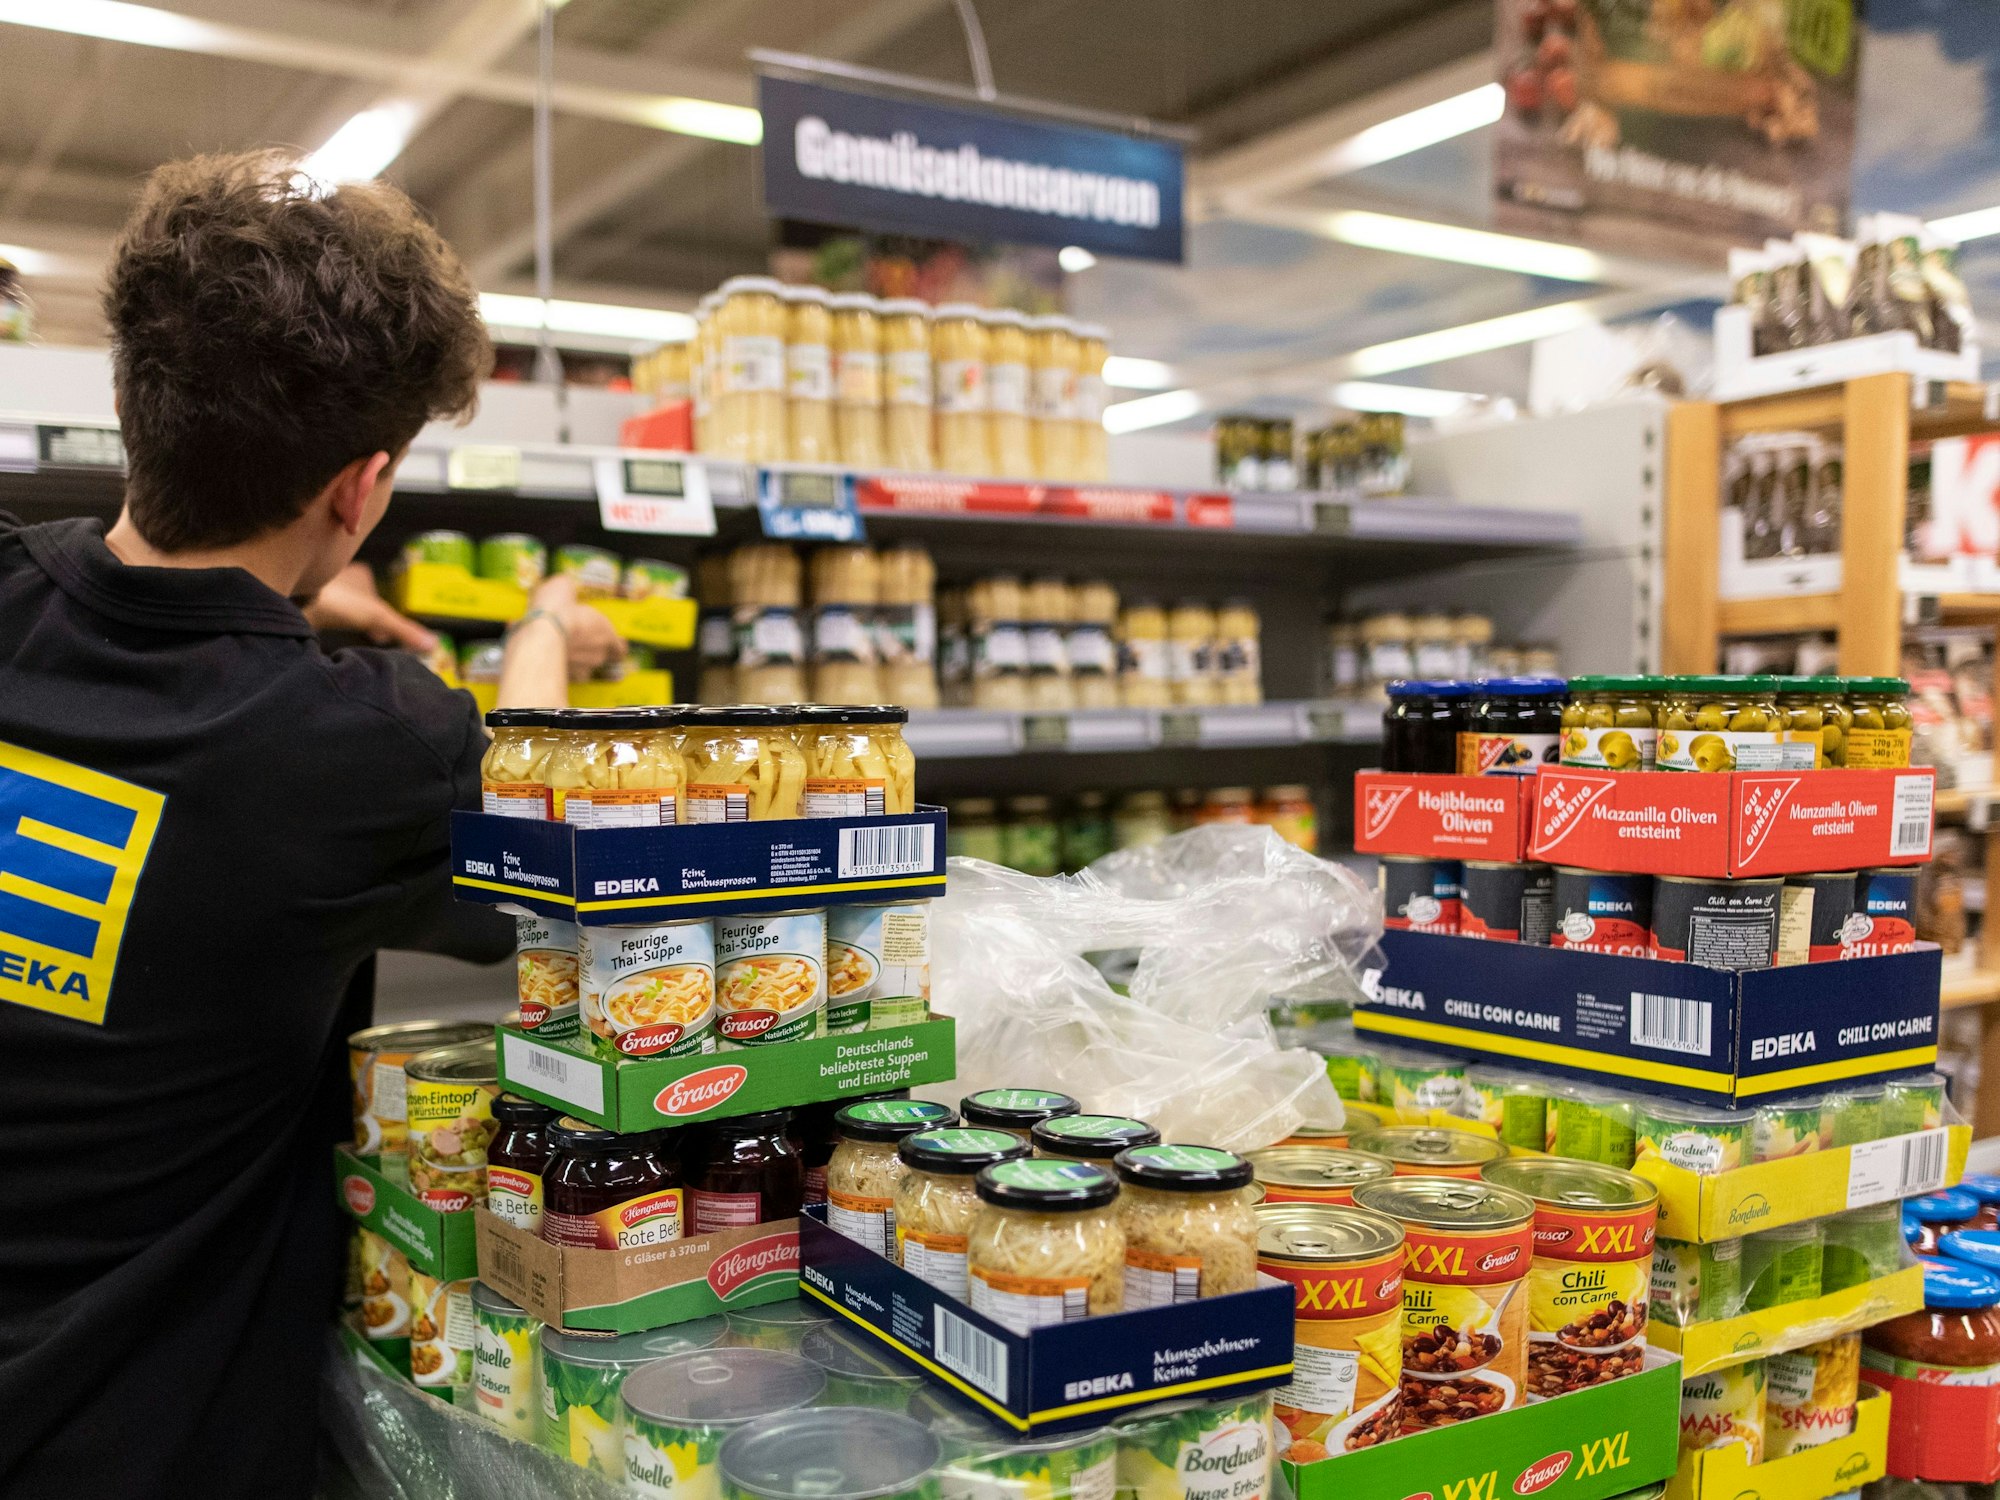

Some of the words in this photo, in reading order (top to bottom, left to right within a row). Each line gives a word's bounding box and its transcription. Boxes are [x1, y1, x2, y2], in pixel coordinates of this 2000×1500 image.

[794, 115, 1161, 229] Gemüsekonserven
[1418, 790, 1505, 817] Hojiblanca
[1543, 781, 1565, 807] GUT
[1744, 786, 1763, 815] GUT
[1544, 785, 1592, 836] GÜNSTIG
[1592, 803, 1666, 823] Mazanilla
[1670, 806, 1718, 824] Oliven
[1746, 787, 1782, 846] GÜNSTIG
[1789, 801, 1846, 820] Manzanilla
[1848, 799, 1878, 817] Oliven
[1442, 812, 1494, 834] Oliven
[1618, 824, 1681, 840] entsteint
[1812, 821, 1855, 836] entsteint
[465, 859, 496, 877] EDEKA
[503, 850, 521, 866] Feine
[842, 867, 847, 876] 4
[852, 864, 886, 876] 311501
[890, 862, 922, 873] 351611
[503, 866, 560, 888] Bambussprossen
[681, 867, 706, 878] Feine
[681, 875, 757, 890] Bambussprossen
[594, 877, 660, 896] EDEKA
[1588, 900, 1634, 912] EDEKA
[1867, 900, 1907, 911] EDEKA
[721, 924, 765, 940] Feurige
[621, 934, 669, 953] Feurige
[611, 943, 683, 971] Thai-Suppe
[721, 1014, 774, 1033] Erasco
[1444, 998, 1481, 1020] CHILI
[1482, 1004, 1513, 1026] CON
[1514, 1010, 1561, 1033] CARNE
[538, 1021, 564, 1034] Natürlich
[764, 1024, 794, 1041] Natürlich
[794, 1019, 809, 1033] lecker
[1751, 1031, 1816, 1061] EDEKA
[1838, 1025, 1870, 1047] CHILI
[1872, 1020, 1896, 1041] CON
[1897, 1015, 1933, 1038] CARNE
[622, 1028, 679, 1053] Erasco
[670, 1038, 697, 1055] Natürlich
[837, 1036, 914, 1059] Deutschlands
[820, 1057, 885, 1077] beliebteste
[887, 1051, 929, 1071] Suppen
[838, 1074, 861, 1090] und
[863, 1067, 911, 1087] Eintöpfe
[667, 1072, 740, 1113] Erasco
[506, 1198, 538, 1216] Bete
[1728, 1201, 1772, 1226] Bonduelle
[618, 1228, 655, 1247] Rote
[659, 1219, 681, 1240] Bete
[1575, 1224, 1637, 1254] XXL
[625, 1255, 632, 1267] 6
[634, 1249, 667, 1266] Gläser
[669, 1246, 676, 1258] à
[678, 1244, 696, 1257] 370
[697, 1241, 710, 1252] ml
[1403, 1242, 1470, 1276] XXL
[1481, 1247, 1519, 1271] Erasco
[804, 1265, 836, 1295] EDEKA
[1562, 1269, 1606, 1289] Chili
[1297, 1277, 1368, 1311] XXL
[1403, 1290, 1433, 1308] hili
[1553, 1296, 1577, 1307] con
[1581, 1290, 1618, 1305] Carne
[1407, 1313, 1449, 1326] Carne
[1153, 1335, 1261, 1367] Mungobohnen-
[481, 1374, 511, 1395] Erbsen
[1153, 1363, 1198, 1384] Keime
[1064, 1371, 1135, 1401] EDEKA
[1185, 1438, 1268, 1476] Bonduelle
[1575, 1430, 1631, 1481] XXL
[1442, 1470, 1500, 1500] XXL
[1520, 1455, 1568, 1493] Erasco
